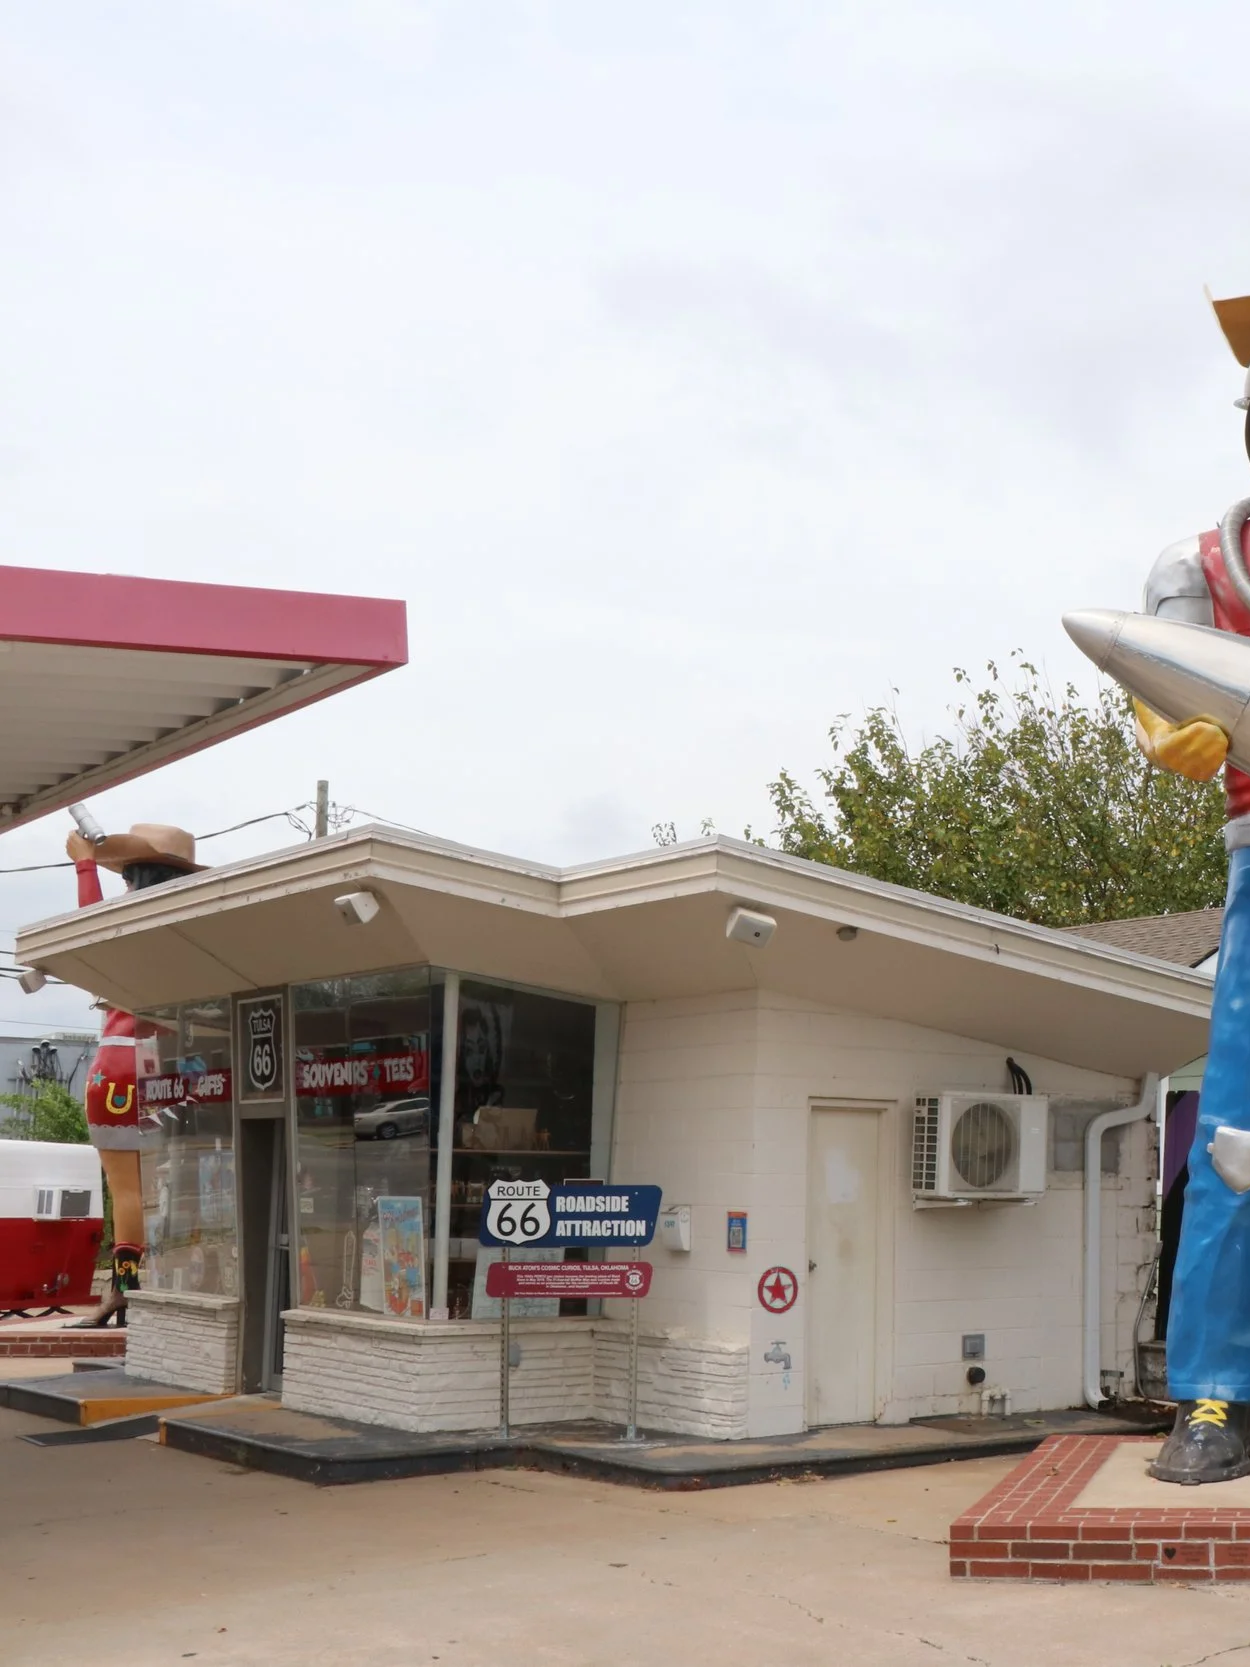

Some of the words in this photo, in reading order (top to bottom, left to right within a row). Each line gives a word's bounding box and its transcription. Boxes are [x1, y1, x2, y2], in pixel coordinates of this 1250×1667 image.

[252, 1018, 272, 1033] TULSA
[253, 1044, 272, 1077] 66
[303, 1060, 369, 1089] SOUVENIRS
[383, 1056, 414, 1083] TEES
[145, 1078, 173, 1102] ROUTE
[173, 1076, 185, 1099] 66
[196, 1073, 225, 1097] GIFTS
[497, 1186, 540, 1197] ROUTE
[555, 1196, 629, 1213] ROADSIDE
[497, 1202, 540, 1237] 66
[555, 1220, 647, 1237] ATTRACTION
